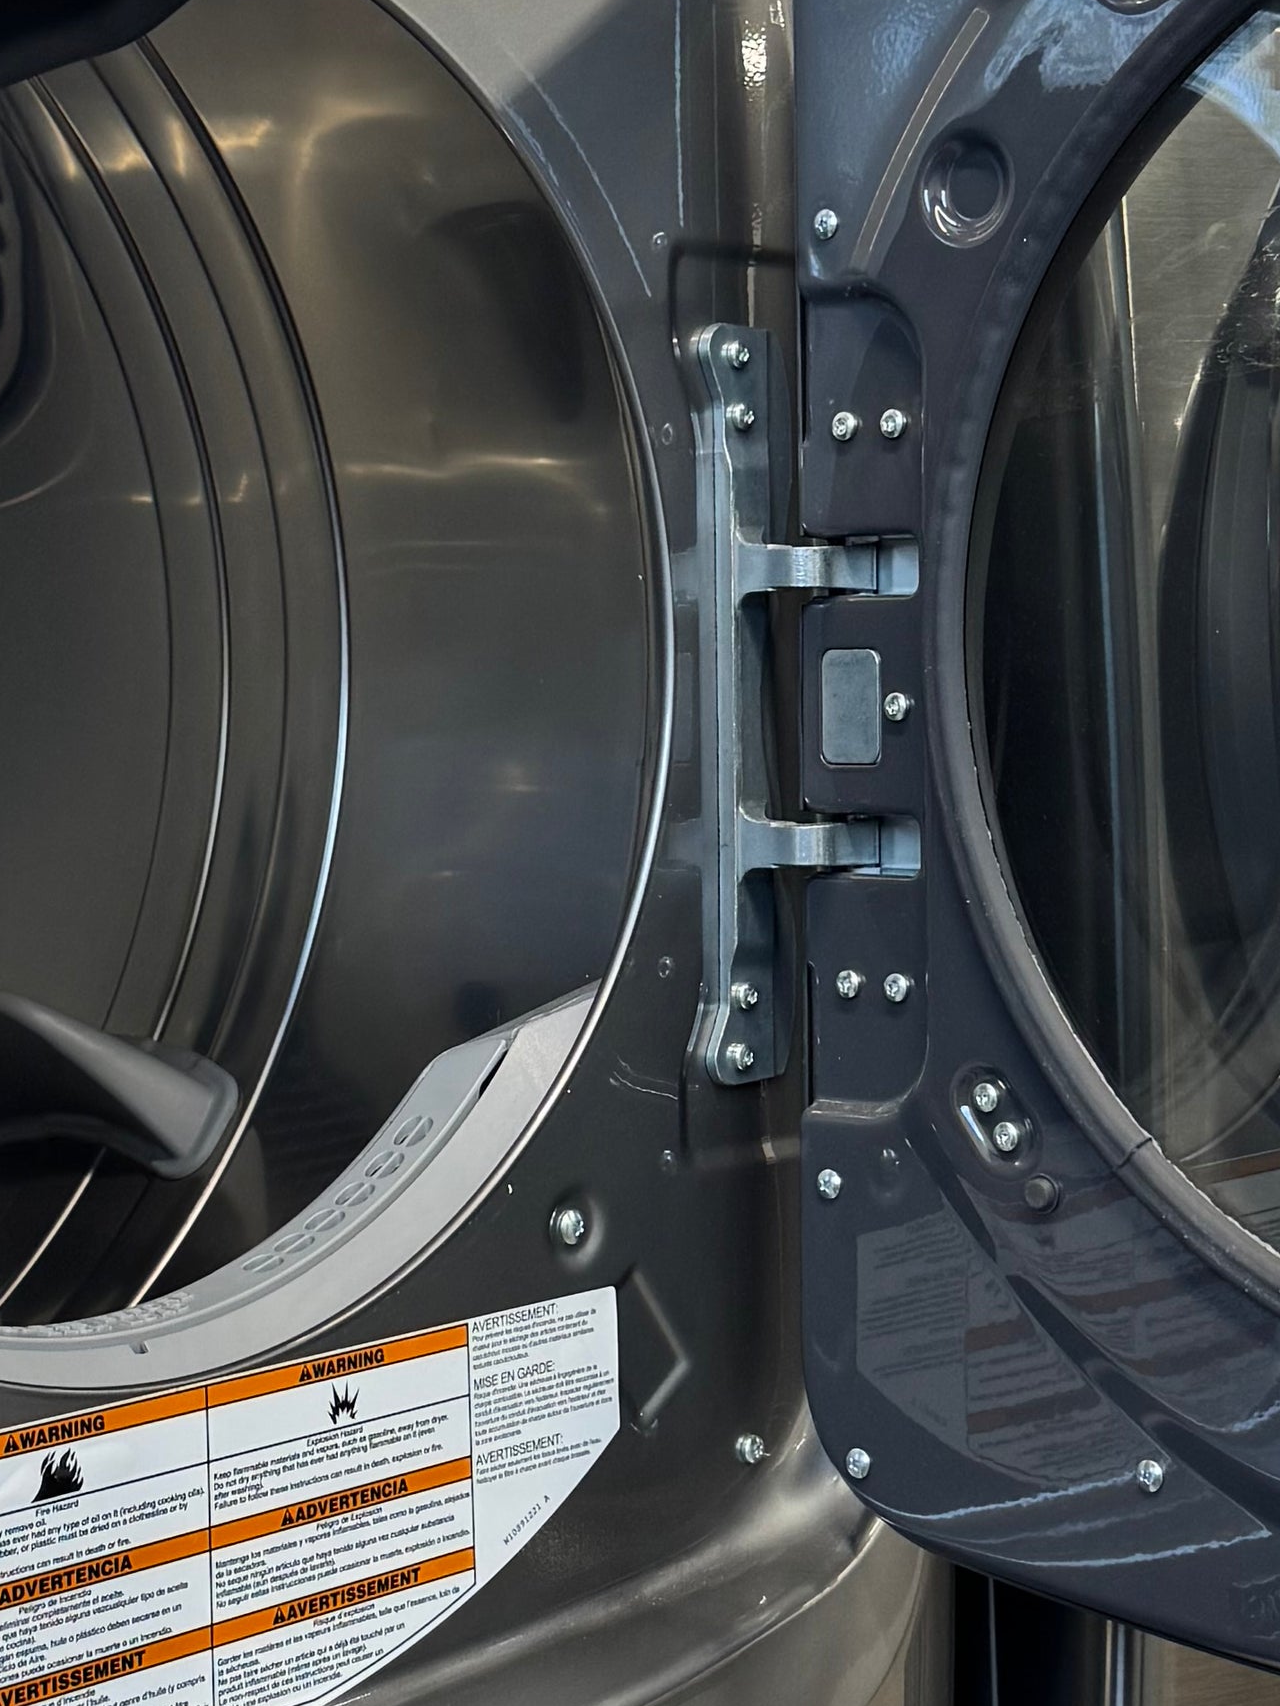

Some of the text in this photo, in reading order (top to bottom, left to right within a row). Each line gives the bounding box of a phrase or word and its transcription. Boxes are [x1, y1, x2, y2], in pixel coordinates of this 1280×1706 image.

[472, 1303, 559, 1333] AVERTISSEMENT:
[311, 1348, 385, 1379] WARNING
[473, 1360, 555, 1391] MISE EN GARDE:
[20, 1415, 105, 1450] WARNING
[475, 1433, 563, 1466] AVERTISSEMENT:
[35, 1499, 79, 1517] Fire Hazard
[295, 1479, 408, 1523] ADVERTENCIA
[31, 1527, 45, 1539] had
[63, 1520, 79, 1532] type
[287, 1567, 422, 1621] AVERTISSEMENT
